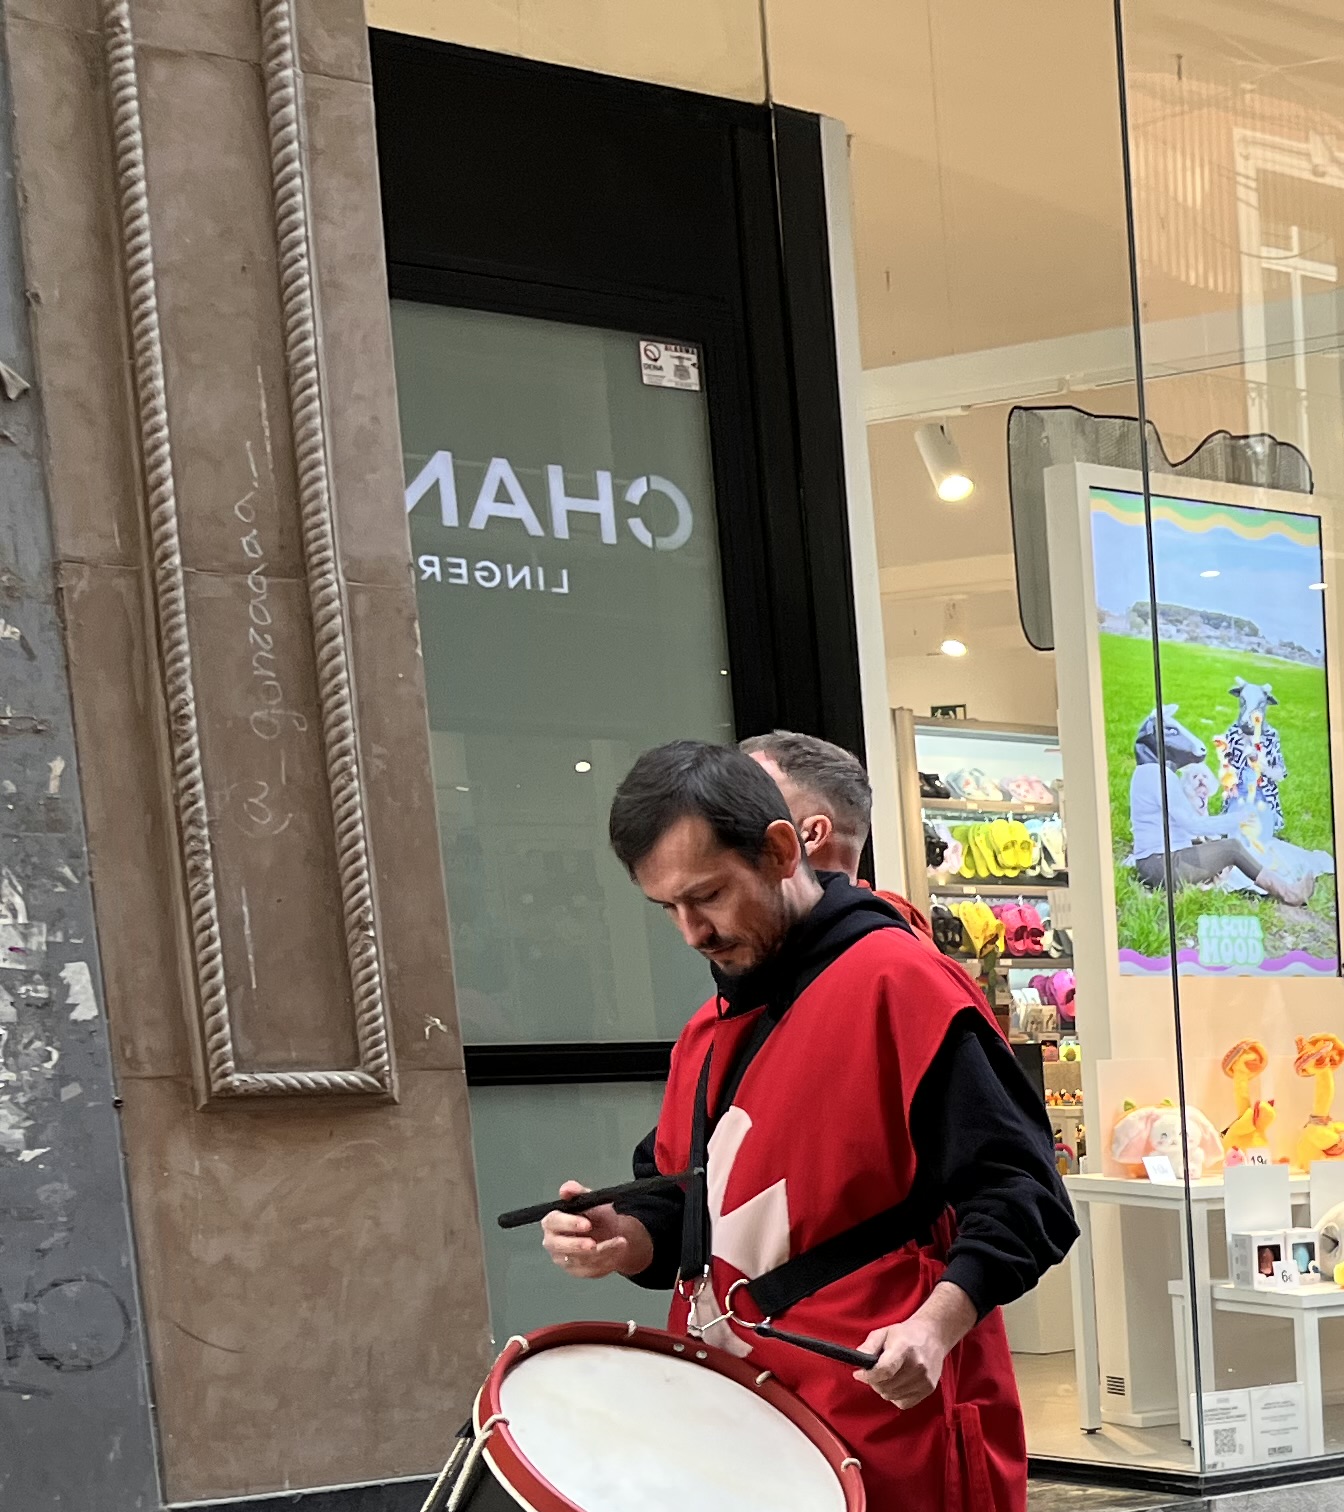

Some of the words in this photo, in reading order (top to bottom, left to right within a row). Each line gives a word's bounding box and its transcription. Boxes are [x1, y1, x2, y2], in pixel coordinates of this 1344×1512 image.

[1198, 916, 1259, 937] PASCUA
[1201, 937, 1260, 963] MOOD
[1281, 1270, 1293, 1282] 6€
